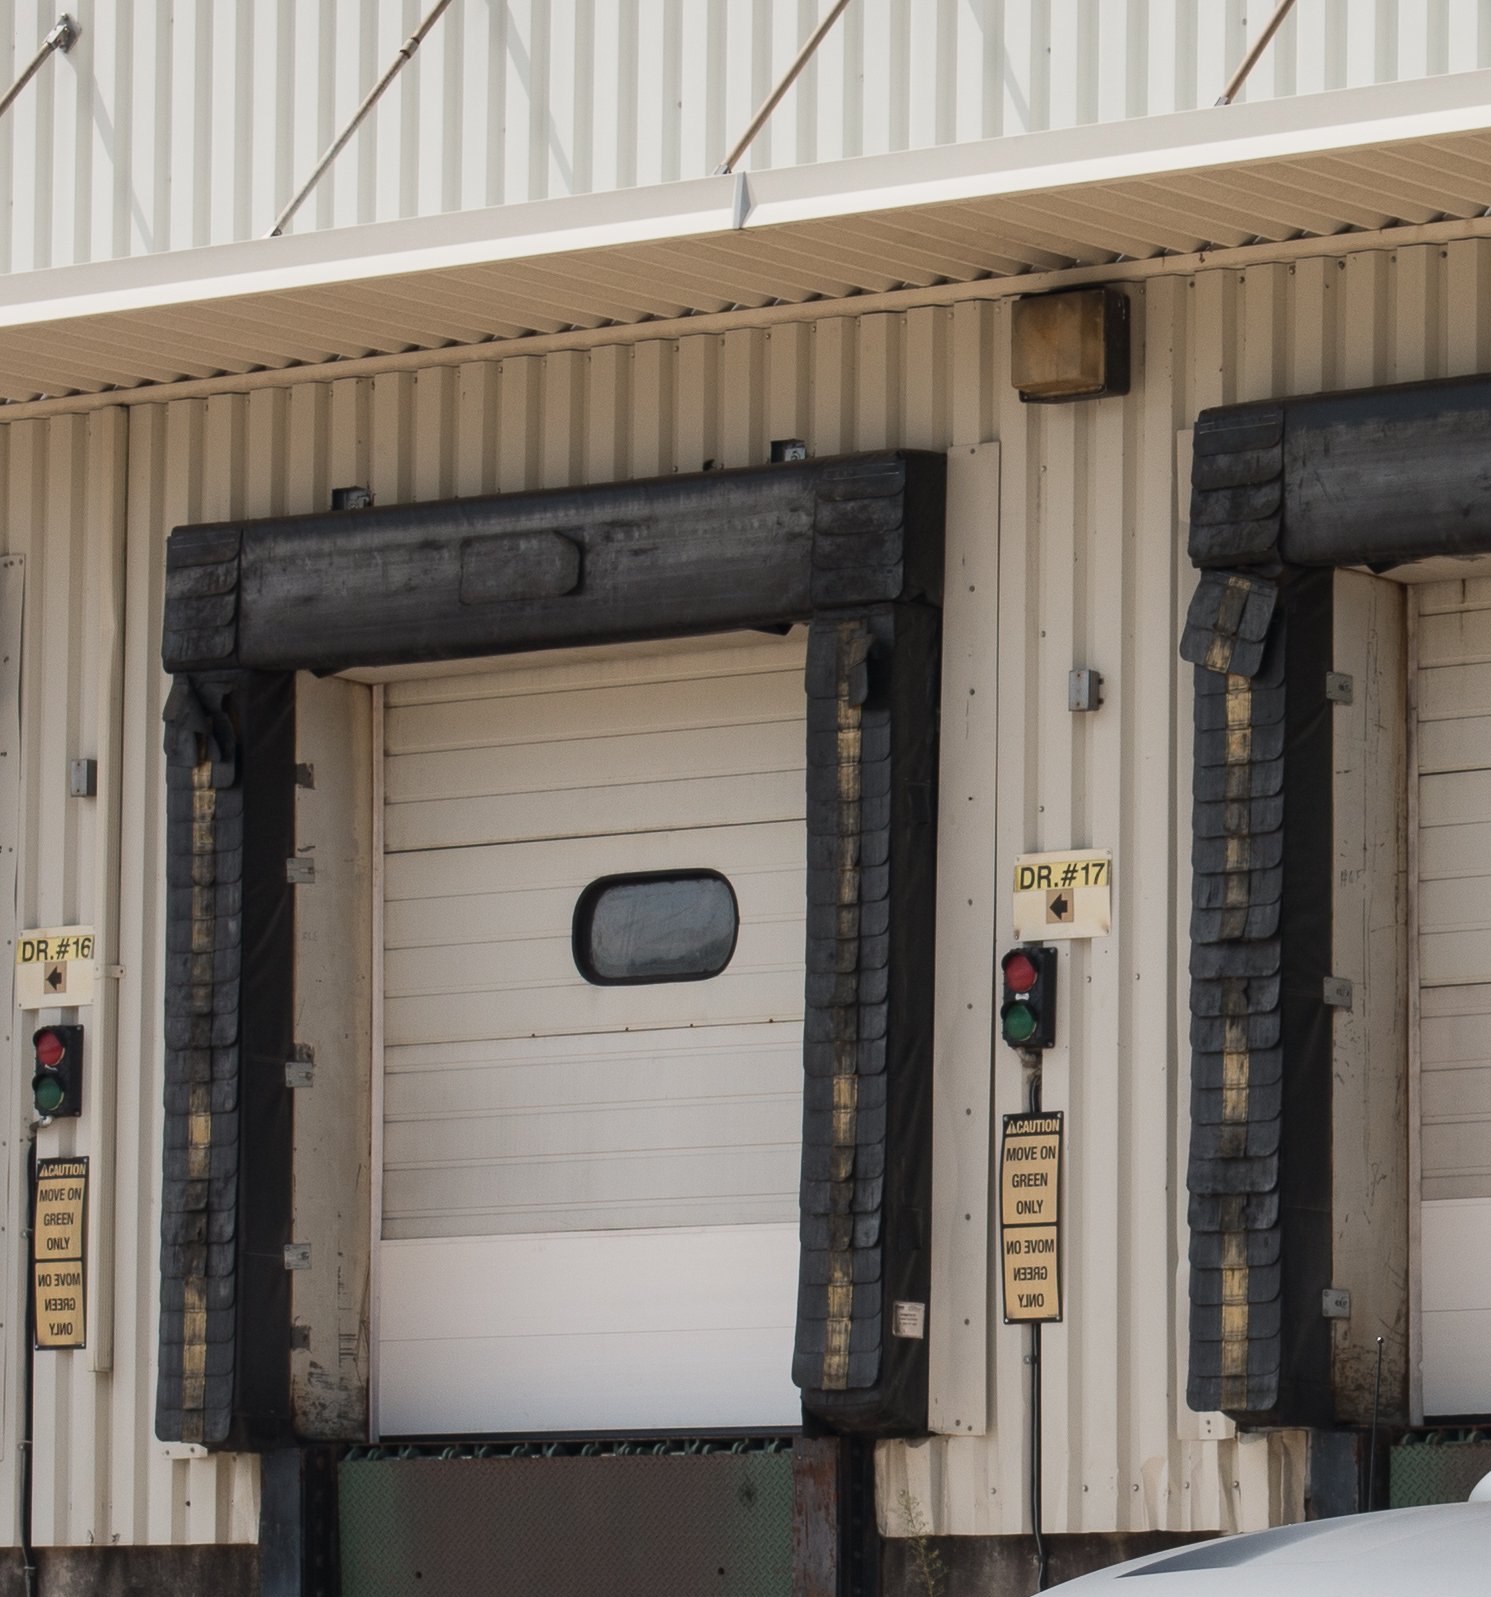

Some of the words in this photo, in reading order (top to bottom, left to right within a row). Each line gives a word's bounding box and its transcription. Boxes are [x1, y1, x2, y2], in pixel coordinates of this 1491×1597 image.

[1020, 863, 1105, 890] DR.#17
[22, 938, 91, 962] DR.#16
[1017, 1119, 1059, 1134] CAUTION
[1006, 1146, 1037, 1162] MOVE
[1040, 1145, 1056, 1160] ON
[48, 1164, 86, 1177] CAUTION
[1012, 1172, 1048, 1188] GREEN
[39, 1188, 66, 1202] MOVE
[67, 1187, 82, 1201] ON
[1016, 1200, 1043, 1215] ONLY
[44, 1212, 74, 1226] GREEN
[46, 1237, 70, 1251] ONLY
